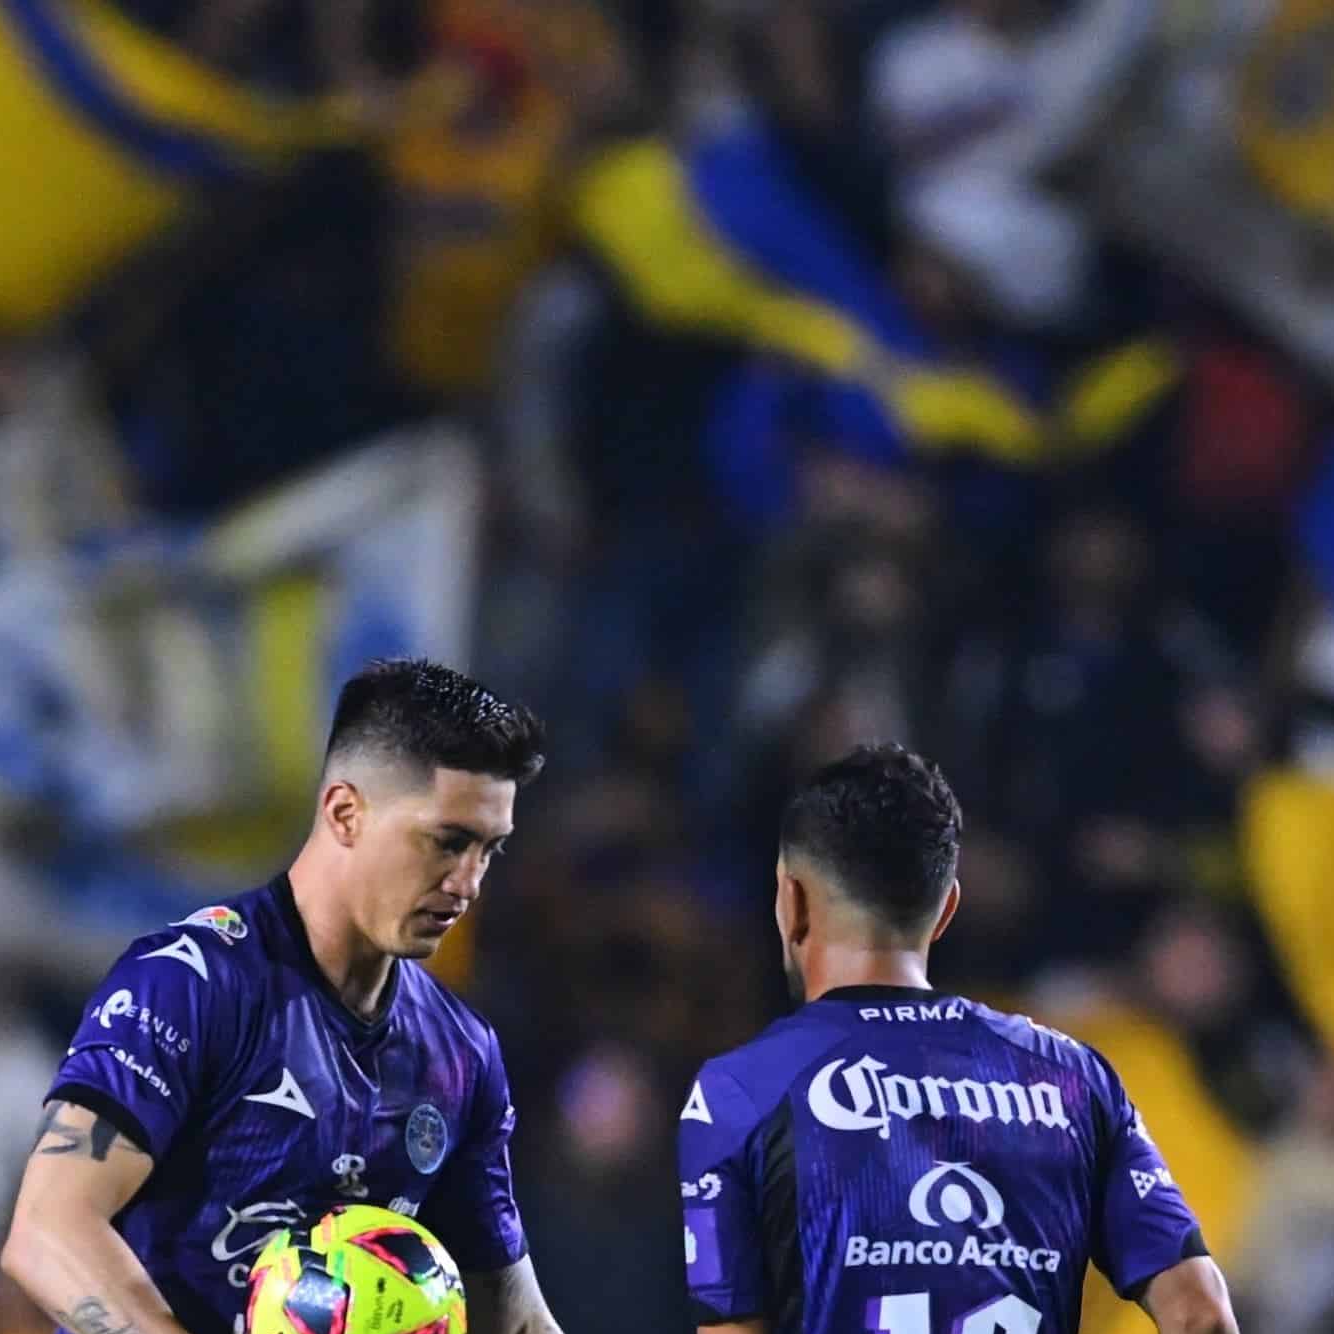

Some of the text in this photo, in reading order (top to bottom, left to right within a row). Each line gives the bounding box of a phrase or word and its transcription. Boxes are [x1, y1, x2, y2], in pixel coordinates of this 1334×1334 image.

[808, 1055, 1071, 1139] Corona
[844, 1235, 1061, 1274] Banco Azteca
